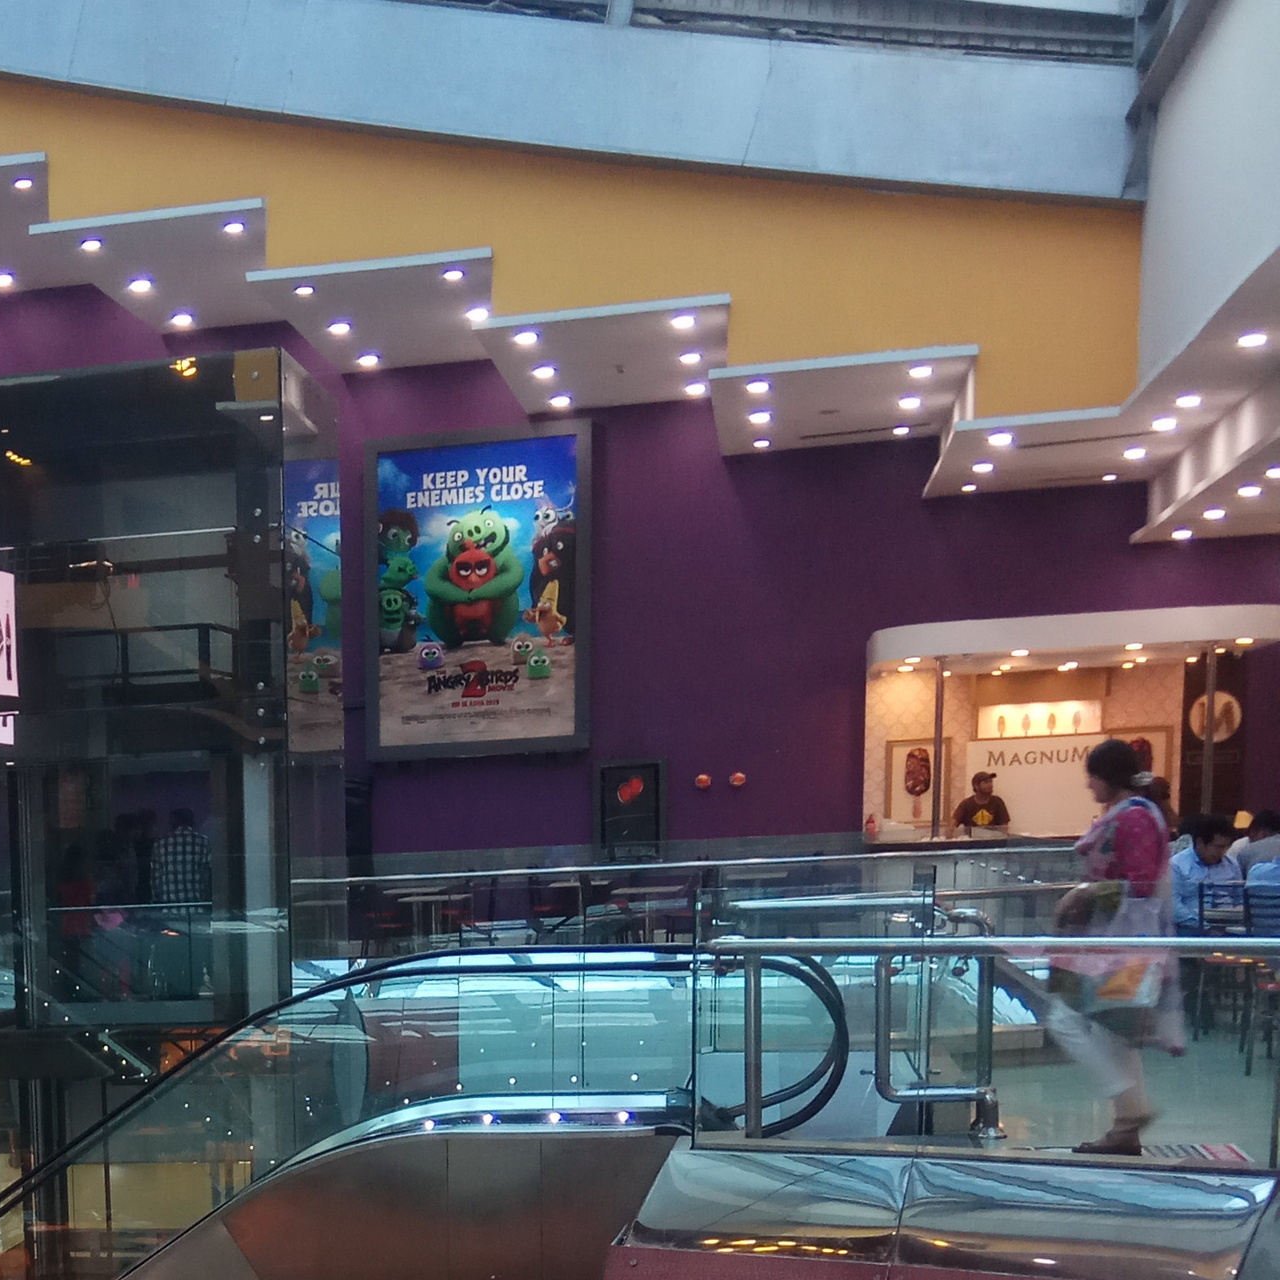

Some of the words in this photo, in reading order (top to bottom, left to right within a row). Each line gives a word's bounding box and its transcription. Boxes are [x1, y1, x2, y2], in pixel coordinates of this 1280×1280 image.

[422, 470, 469, 490] KEEP
[475, 464, 528, 485] YOUR
[406, 484, 485, 509] ENEMIES
[490, 480, 545, 502] CLOSE
[986, 746, 1090, 767] MAGNUM
